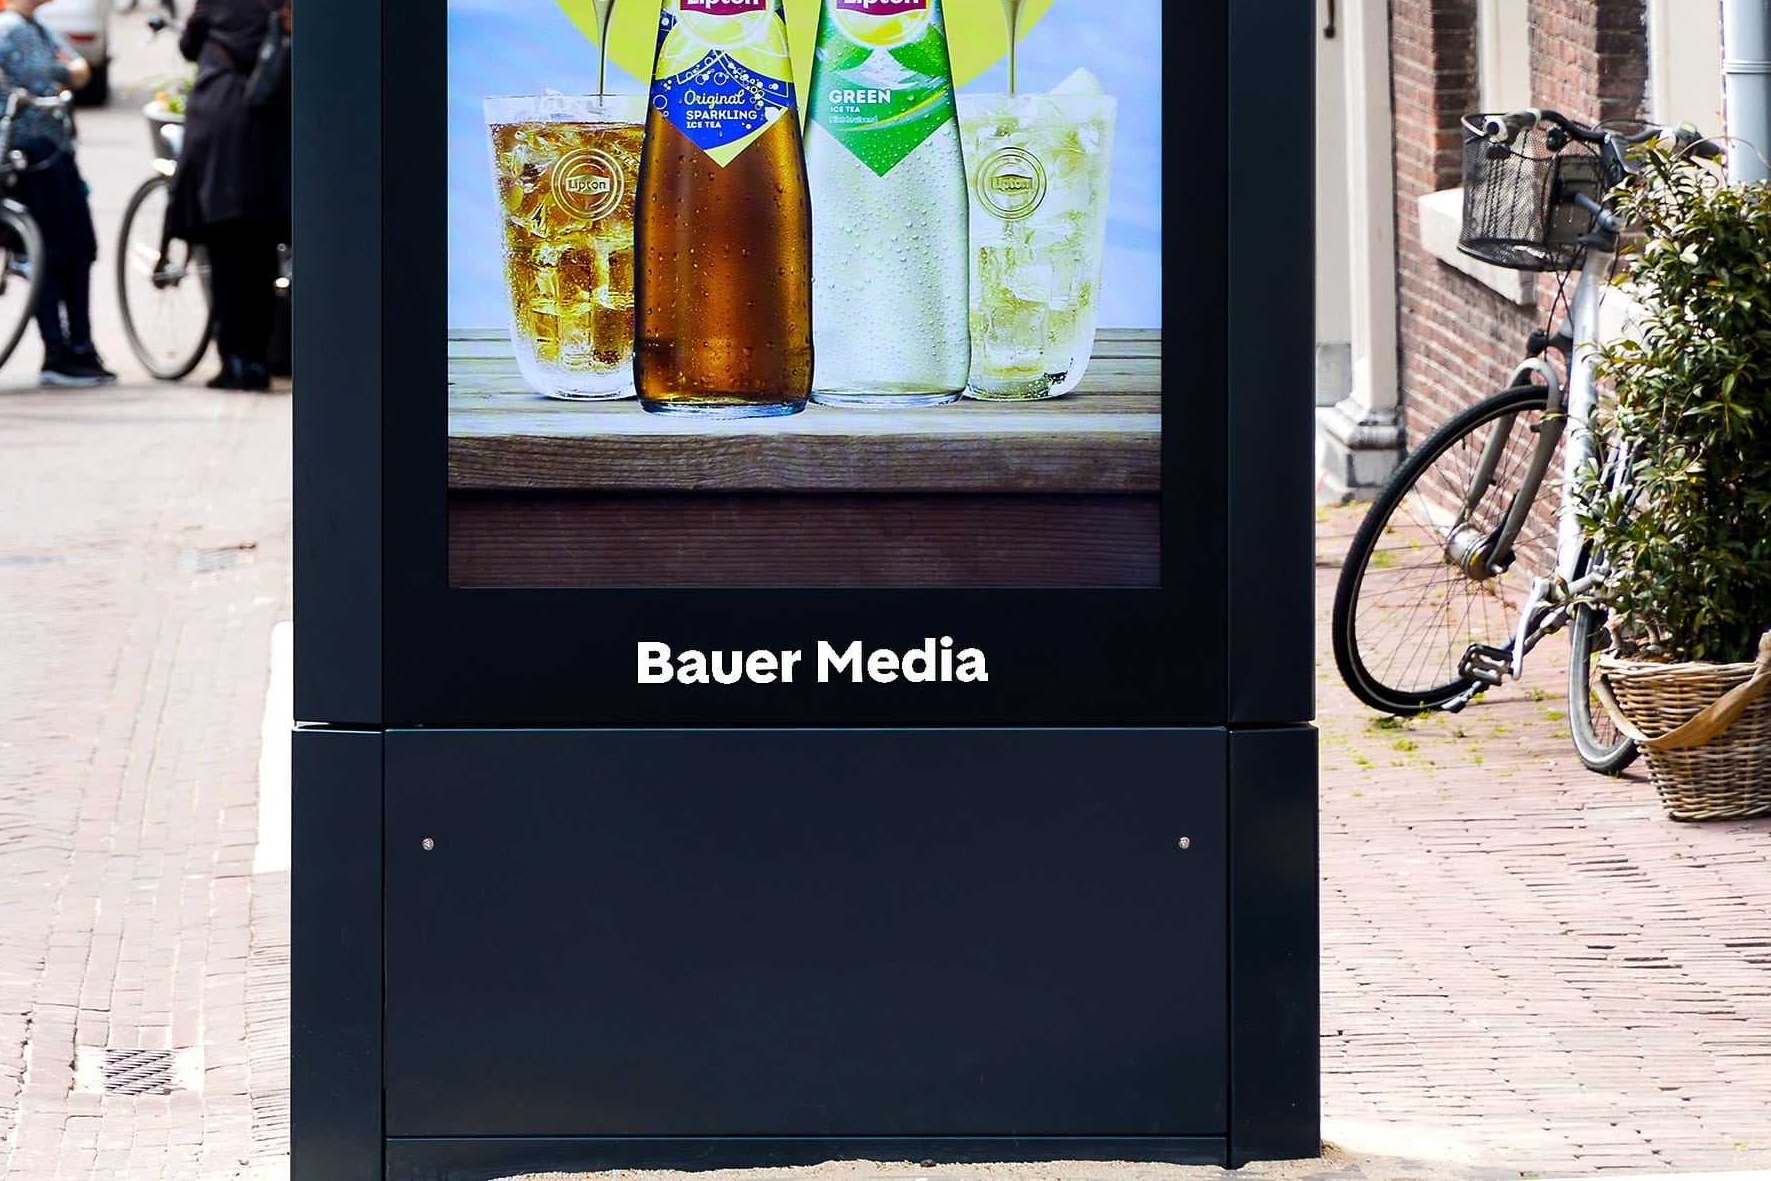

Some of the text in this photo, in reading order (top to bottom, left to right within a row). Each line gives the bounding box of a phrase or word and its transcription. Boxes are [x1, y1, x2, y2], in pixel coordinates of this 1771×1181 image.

[684, 89, 746, 109] Original
[828, 89, 891, 104] GREEN
[686, 109, 758, 120] SPARKLING
[686, 121, 722, 129] ICE TEA
[568, 179, 607, 192] Lipton
[637, 635, 989, 684] Bauer Media
